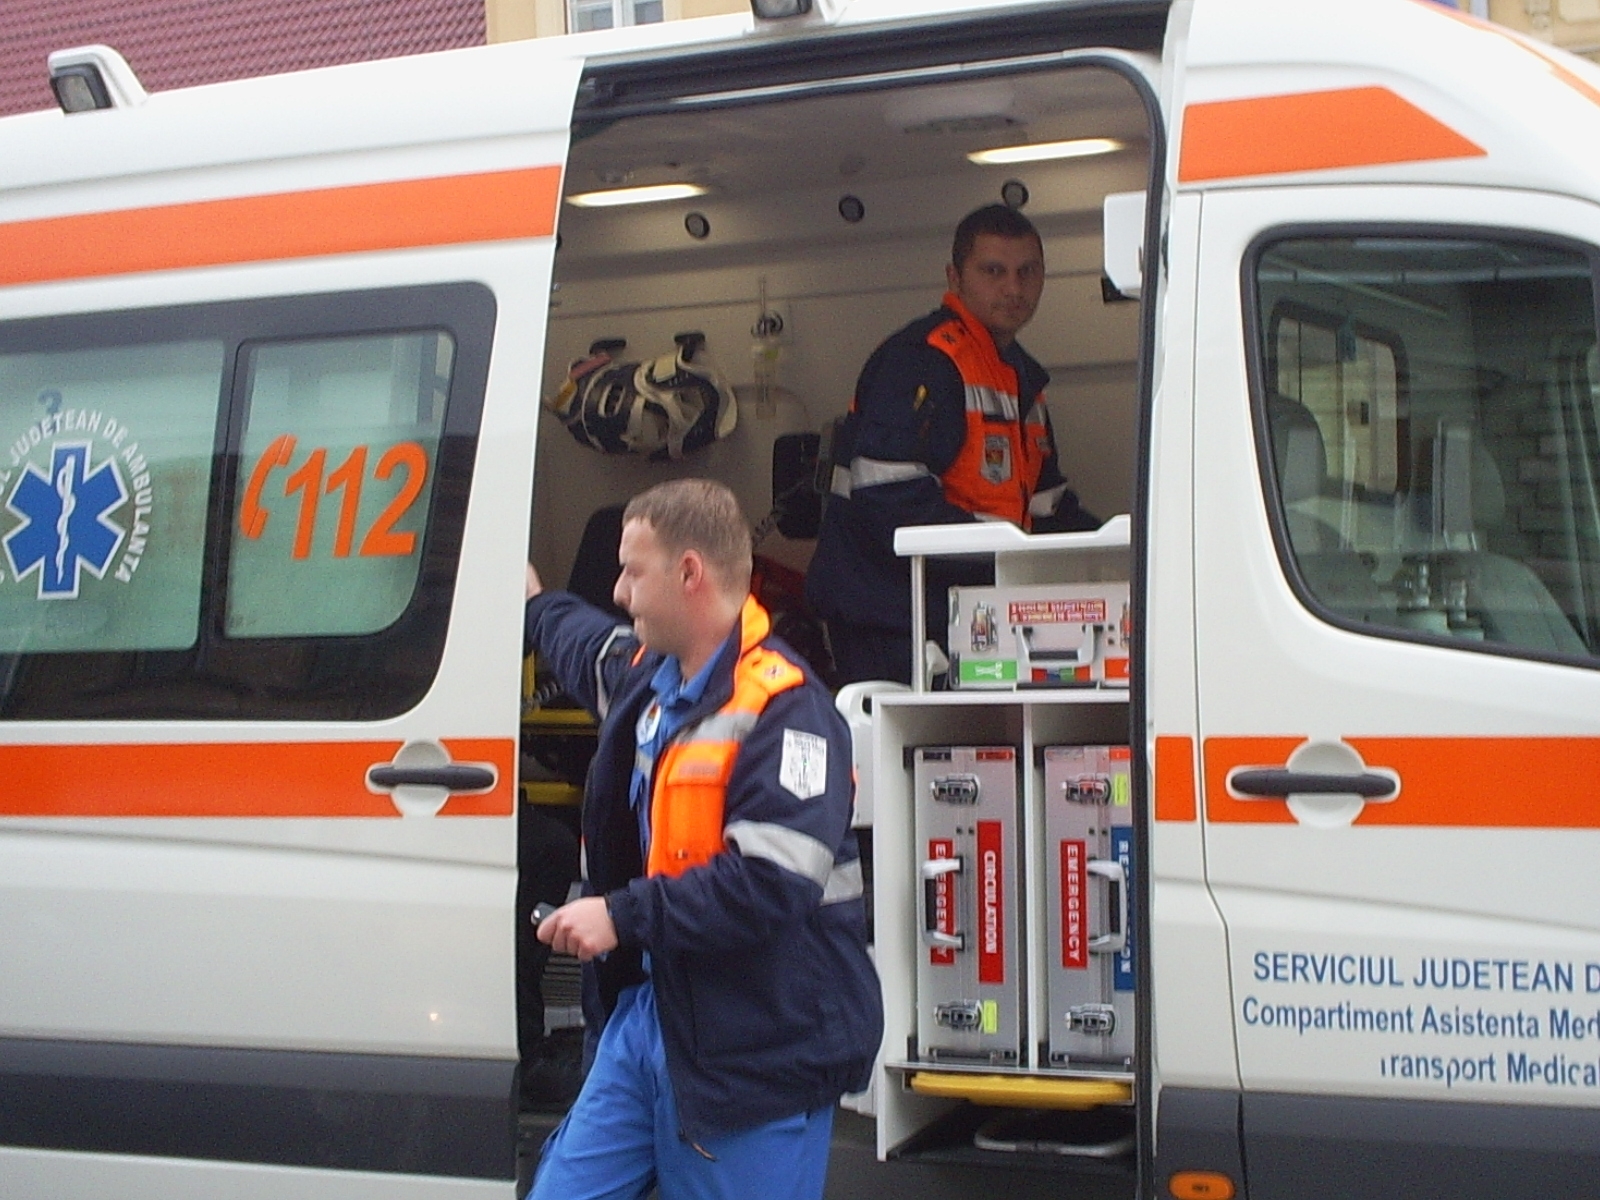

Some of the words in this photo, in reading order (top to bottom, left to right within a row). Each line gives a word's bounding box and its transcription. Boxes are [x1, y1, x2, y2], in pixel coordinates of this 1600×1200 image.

[10, 409, 102, 467] JUDETEAN
[102, 417, 129, 448] DE
[114, 442, 153, 583] AMBULANTA
[284, 441, 429, 559] 112
[983, 850, 997, 954] CIRCULATION
[1067, 844, 1080, 962] EMERGENCY
[1253, 952, 1404, 987] SERVICIUL
[1413, 957, 1574, 993] JUDETEAN
[1242, 996, 1414, 1036] Compartiment
[1421, 1004, 1541, 1039] Asistenta
[1507, 1052, 1600, 1087] Medica
